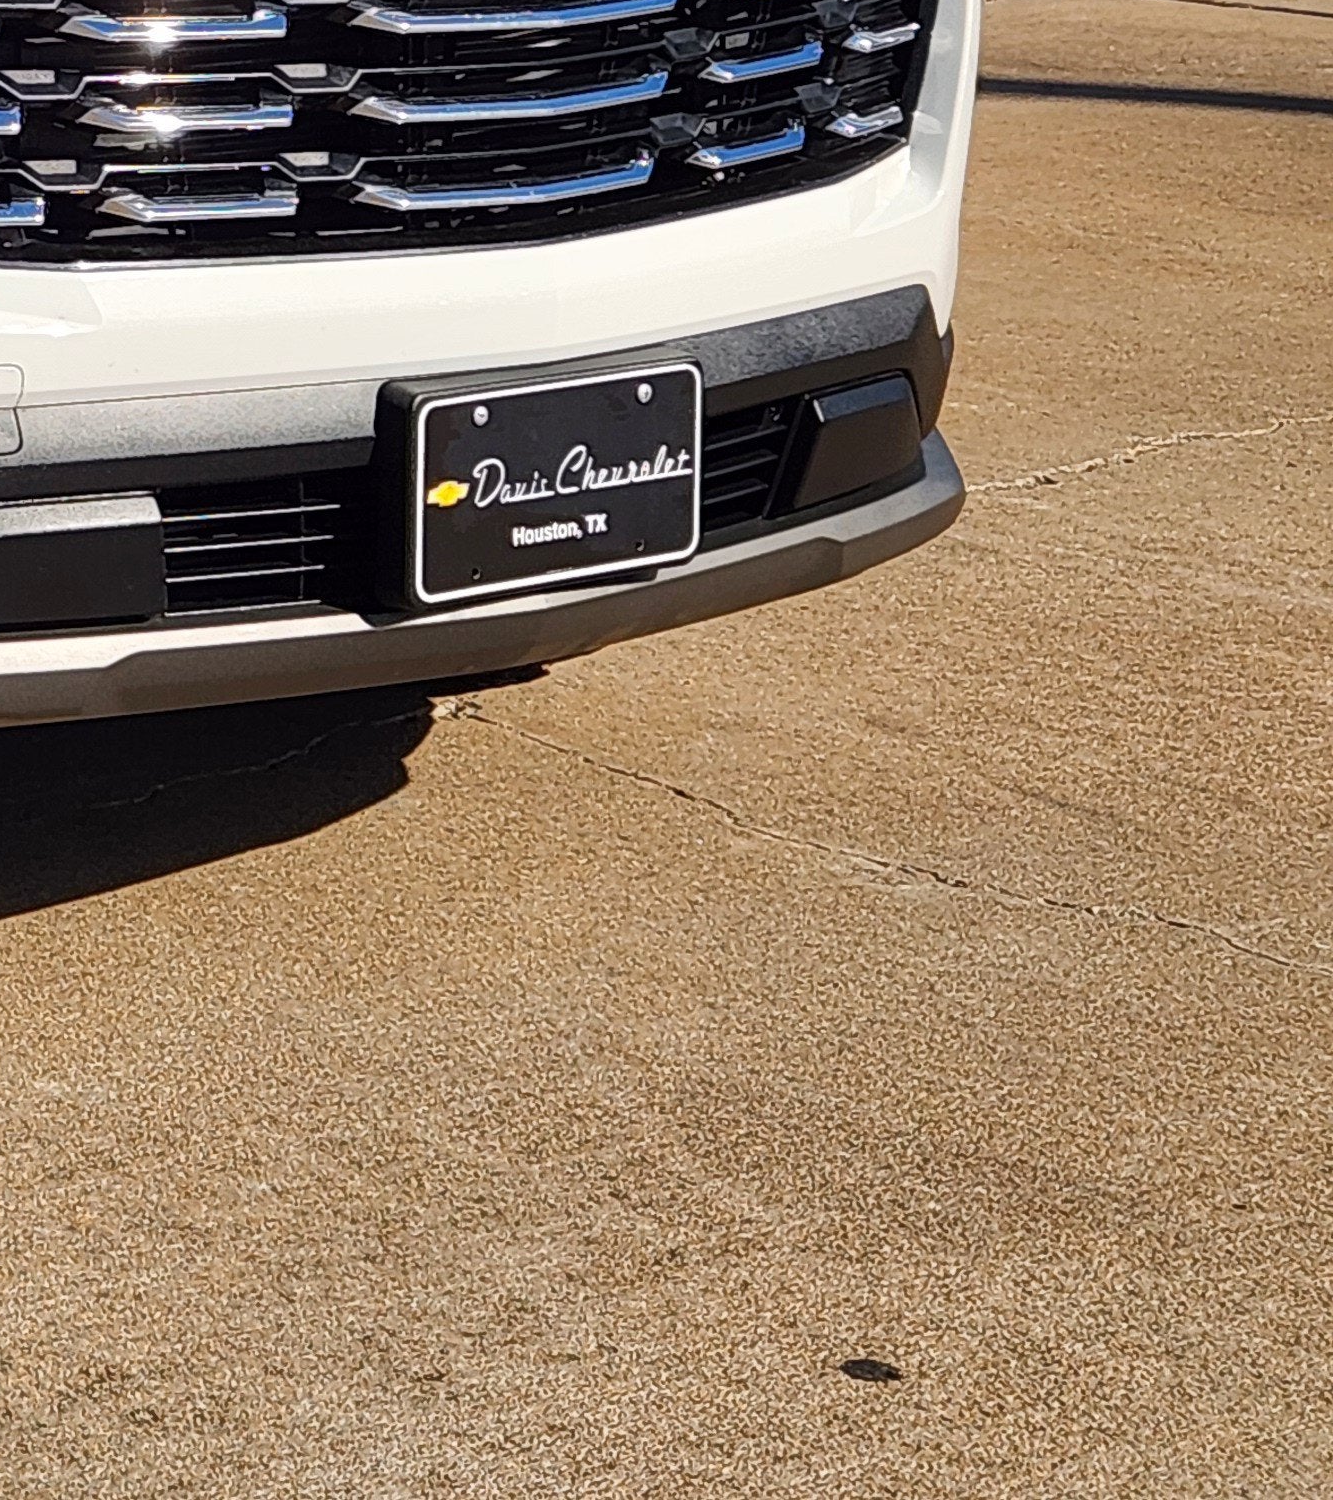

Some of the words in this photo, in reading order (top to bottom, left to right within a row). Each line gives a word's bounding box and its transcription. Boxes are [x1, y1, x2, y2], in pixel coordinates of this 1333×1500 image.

[472, 457, 555, 508] Davis
[555, 444, 693, 495] Chevrolet
[512, 520, 582, 548] Houston,
[584, 512, 608, 535] TX
